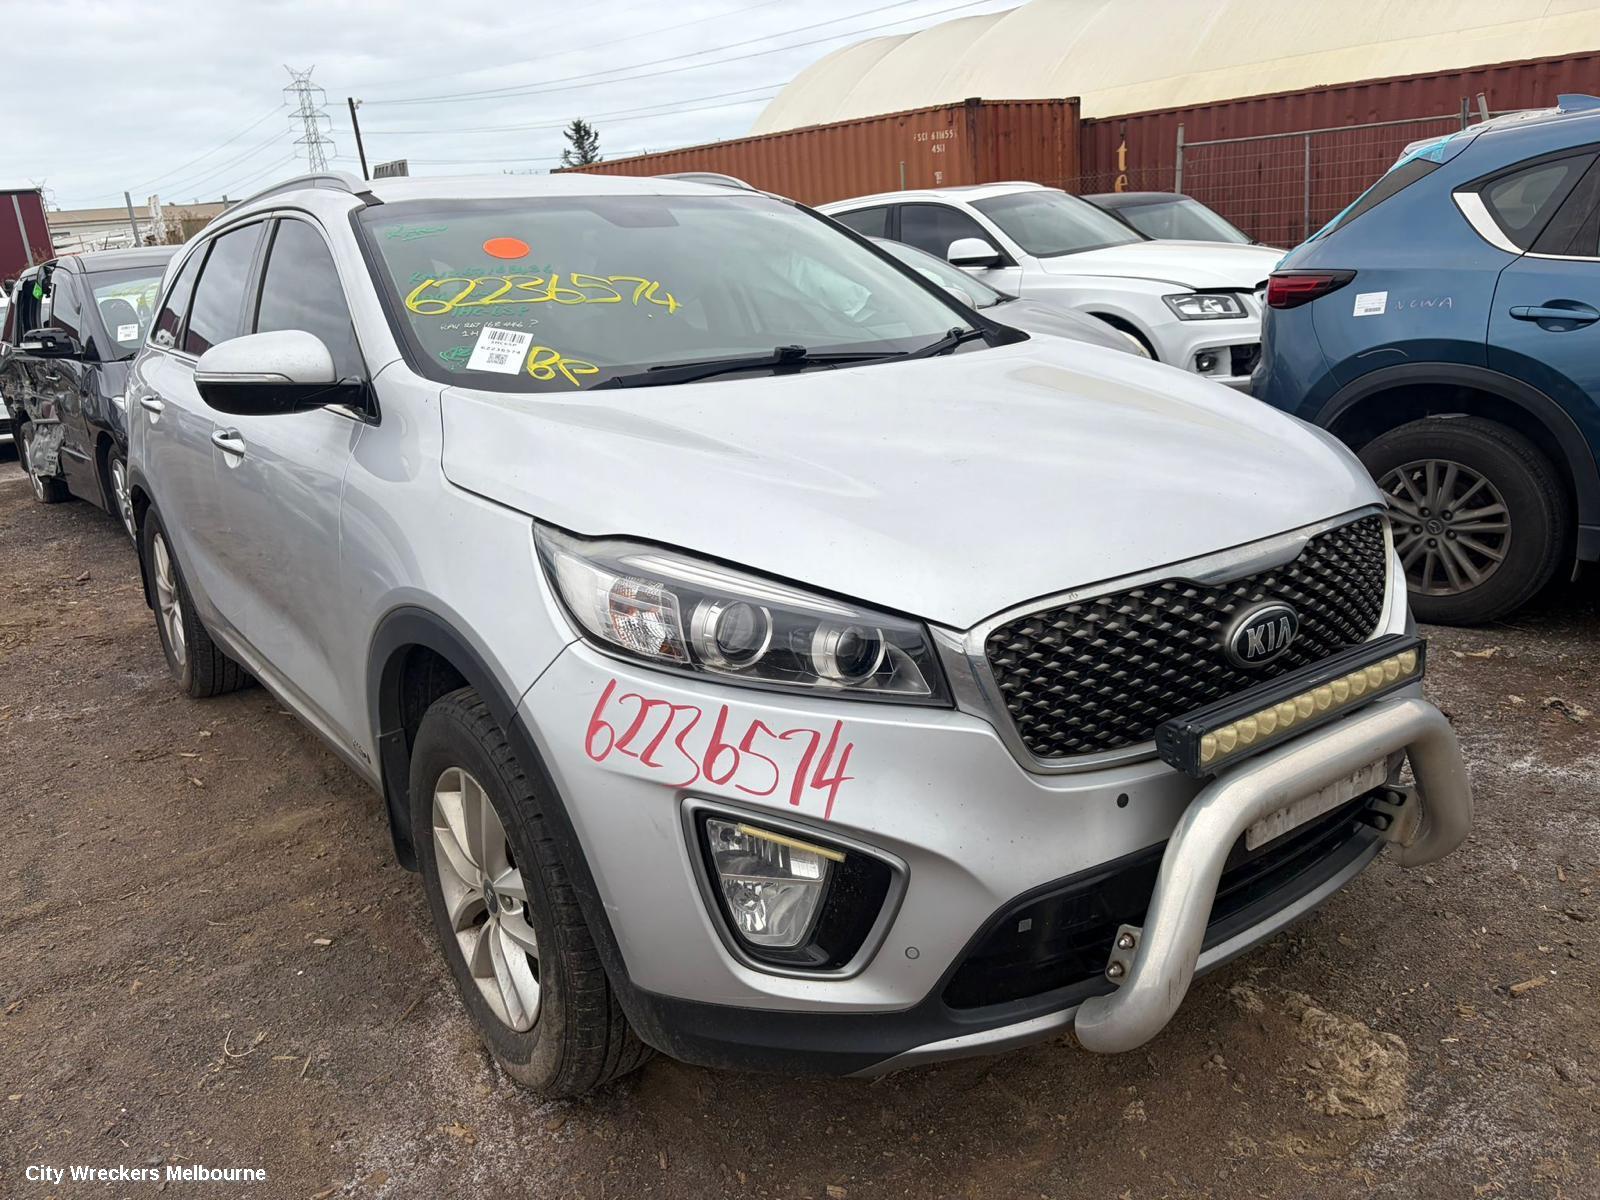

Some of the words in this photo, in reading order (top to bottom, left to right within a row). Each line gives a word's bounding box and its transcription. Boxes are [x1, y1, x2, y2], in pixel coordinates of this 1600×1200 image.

[405, 273, 683, 315] 62236574
[1246, 616, 1292, 658] KIA
[585, 678, 855, 822] 62236574
